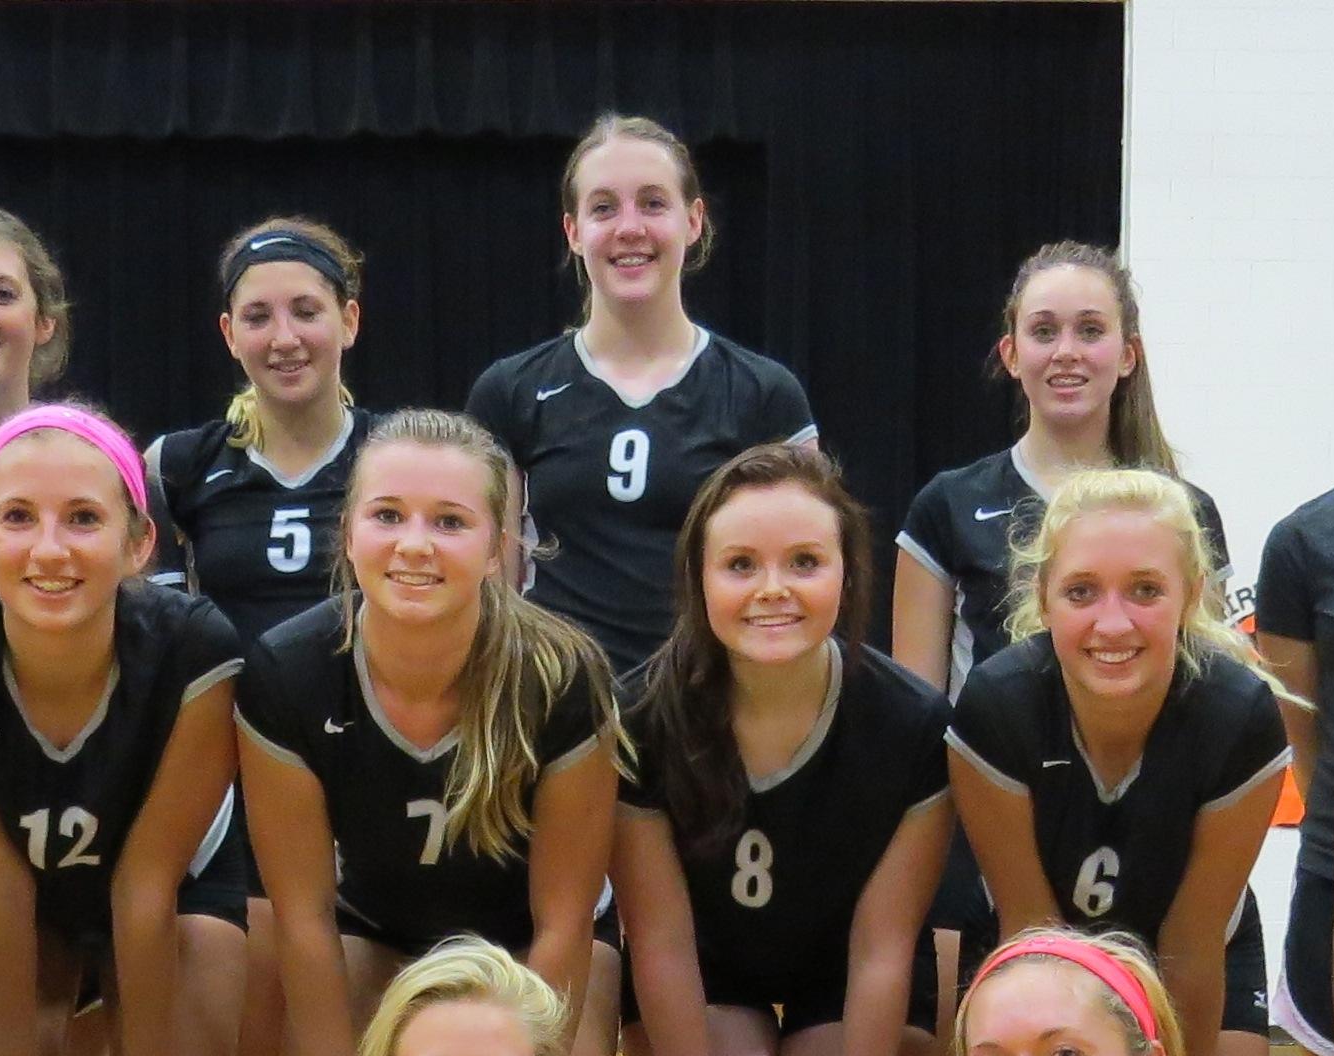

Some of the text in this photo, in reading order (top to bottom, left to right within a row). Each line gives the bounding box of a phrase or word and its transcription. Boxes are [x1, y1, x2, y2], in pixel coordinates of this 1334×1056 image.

[608, 429, 649, 500] 9
[267, 509, 311, 572] 5
[20, 806, 100, 869] 12
[407, 799, 448, 864] 7
[732, 830, 773, 907] 8
[1073, 847, 1119, 917] 6
